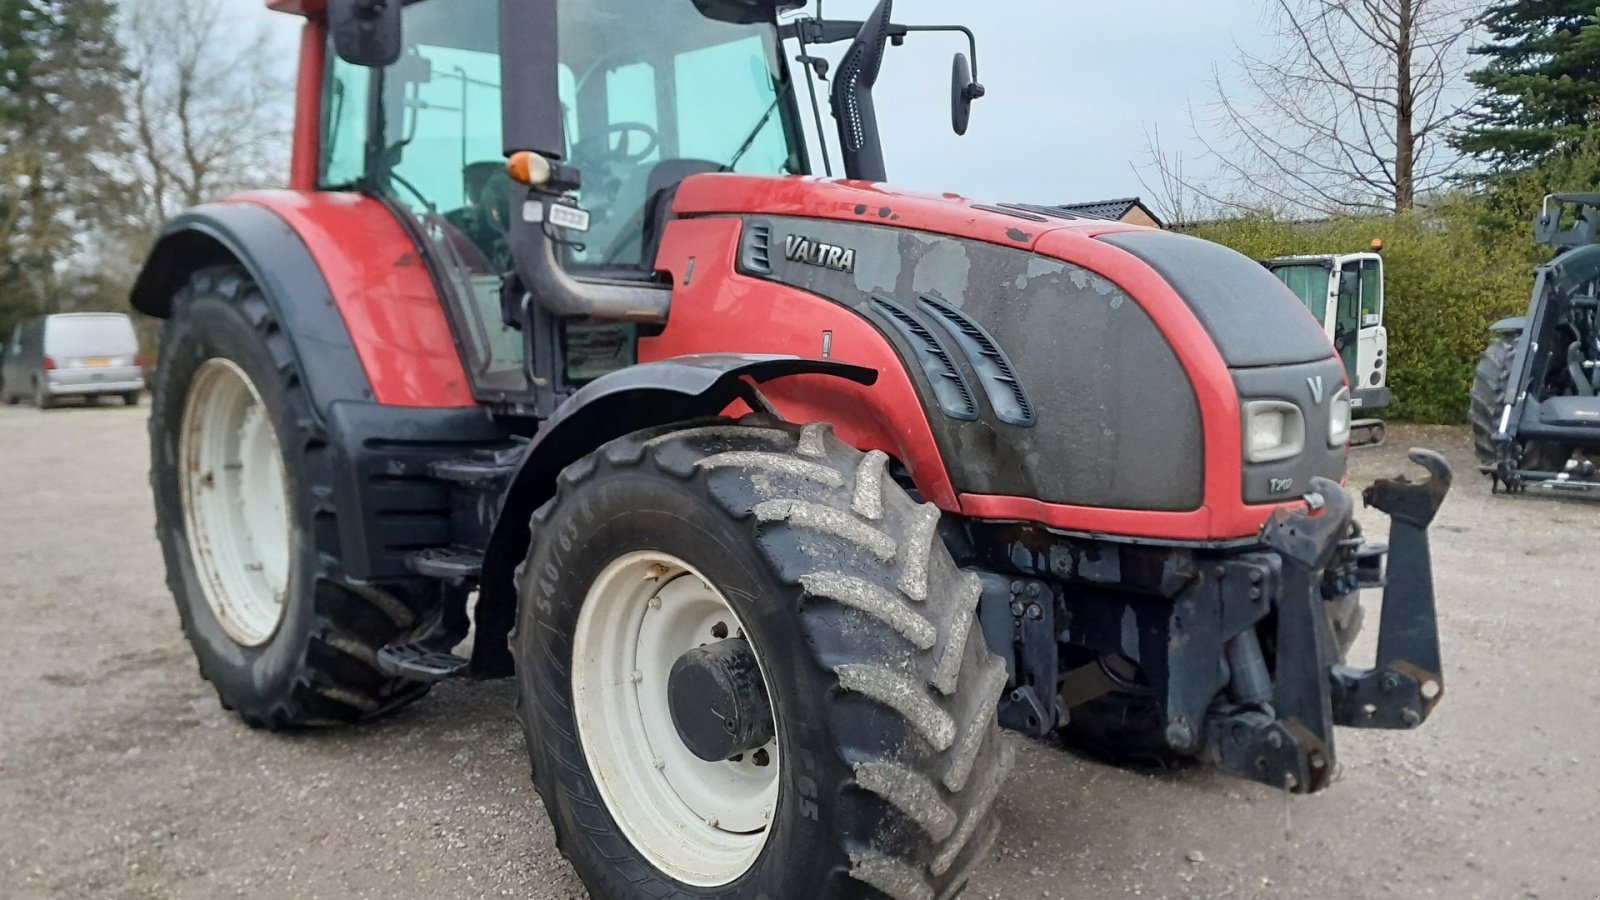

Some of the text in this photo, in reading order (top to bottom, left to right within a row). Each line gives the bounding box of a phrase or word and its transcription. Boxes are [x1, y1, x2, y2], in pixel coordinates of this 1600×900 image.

[785, 234, 856, 273] VALTRA
[1307, 375, 1323, 404] V
[536, 516, 579, 616] 540/65
